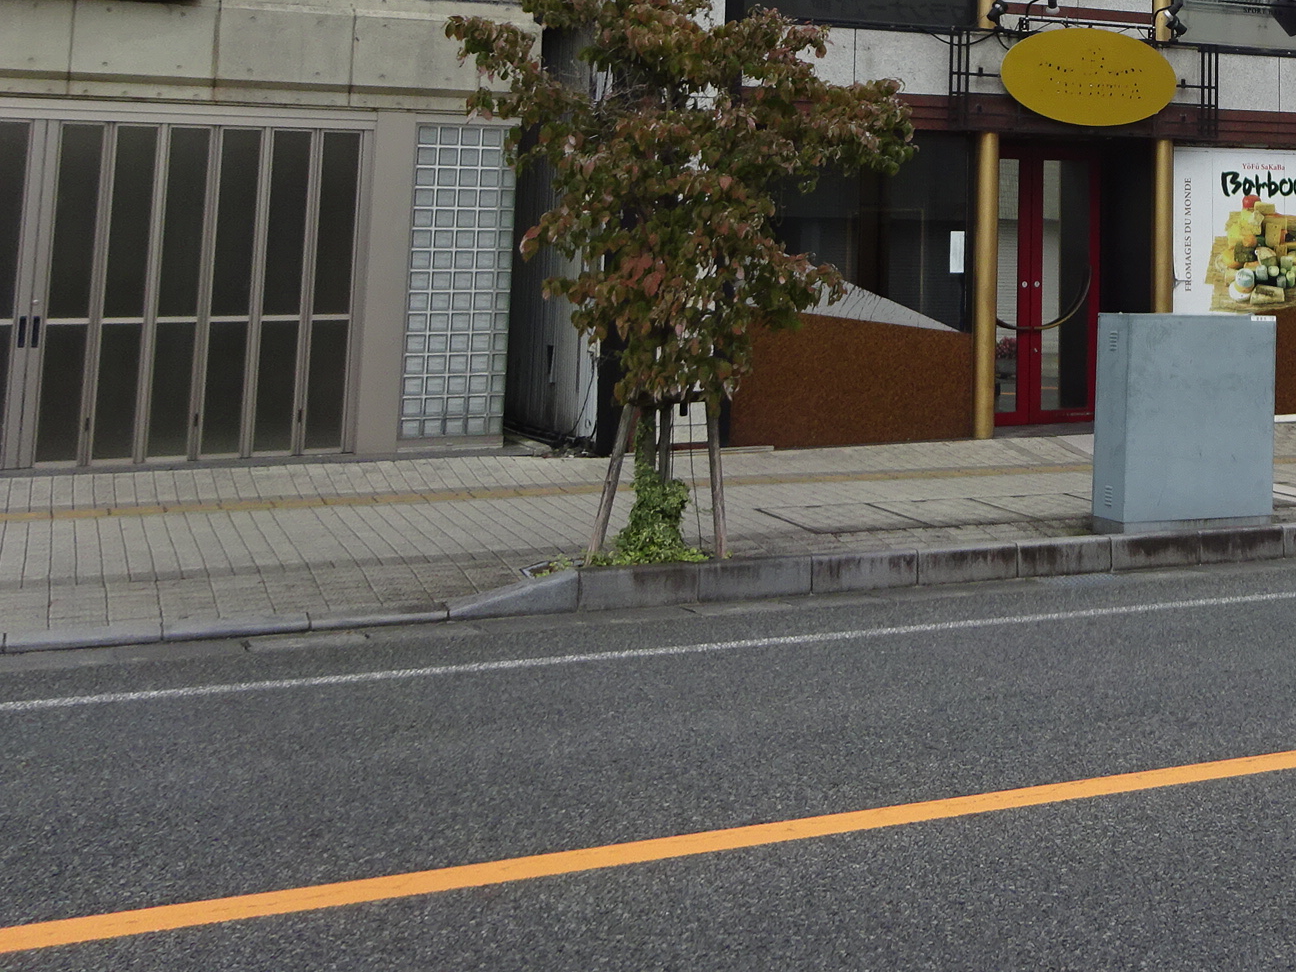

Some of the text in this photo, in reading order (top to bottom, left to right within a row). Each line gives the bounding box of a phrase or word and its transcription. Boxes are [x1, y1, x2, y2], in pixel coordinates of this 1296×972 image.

[1184, 177, 1192, 292] FROMAGES DU MONDE
